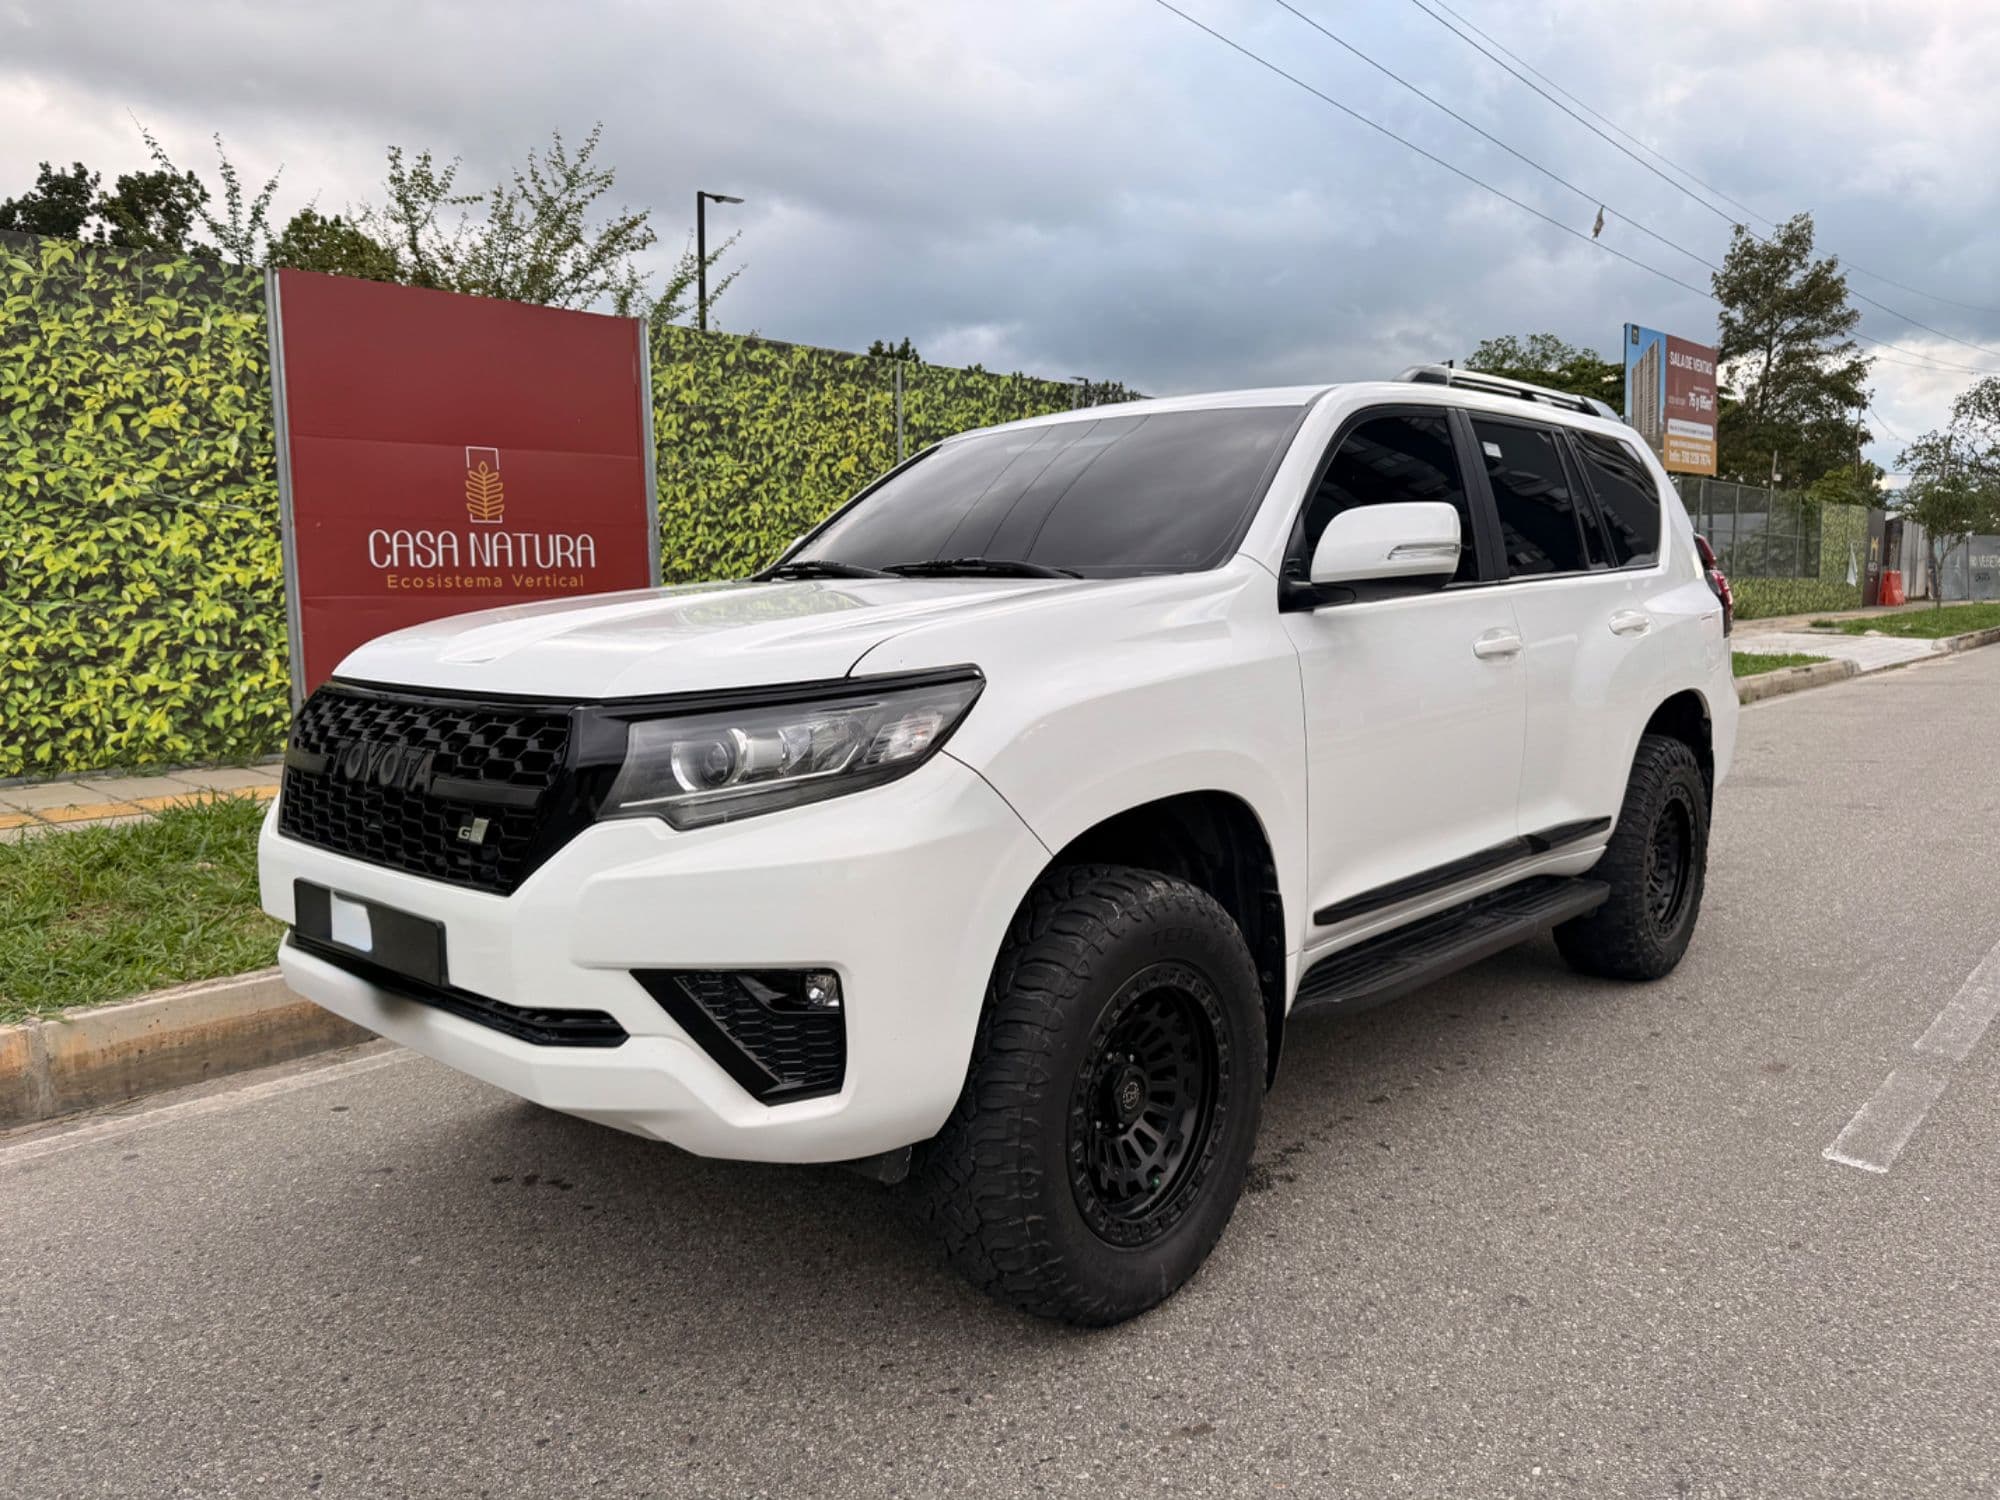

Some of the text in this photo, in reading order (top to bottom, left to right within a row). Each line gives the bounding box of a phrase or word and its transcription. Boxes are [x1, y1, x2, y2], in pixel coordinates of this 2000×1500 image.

[1669, 351, 1685, 369] SALA
[1692, 357, 1713, 376] VENTAS
[368, 529, 596, 569] CASA NATURA
[387, 573, 585, 589] Ecosistema Vertical
[332, 738, 436, 792] TOYOTA
